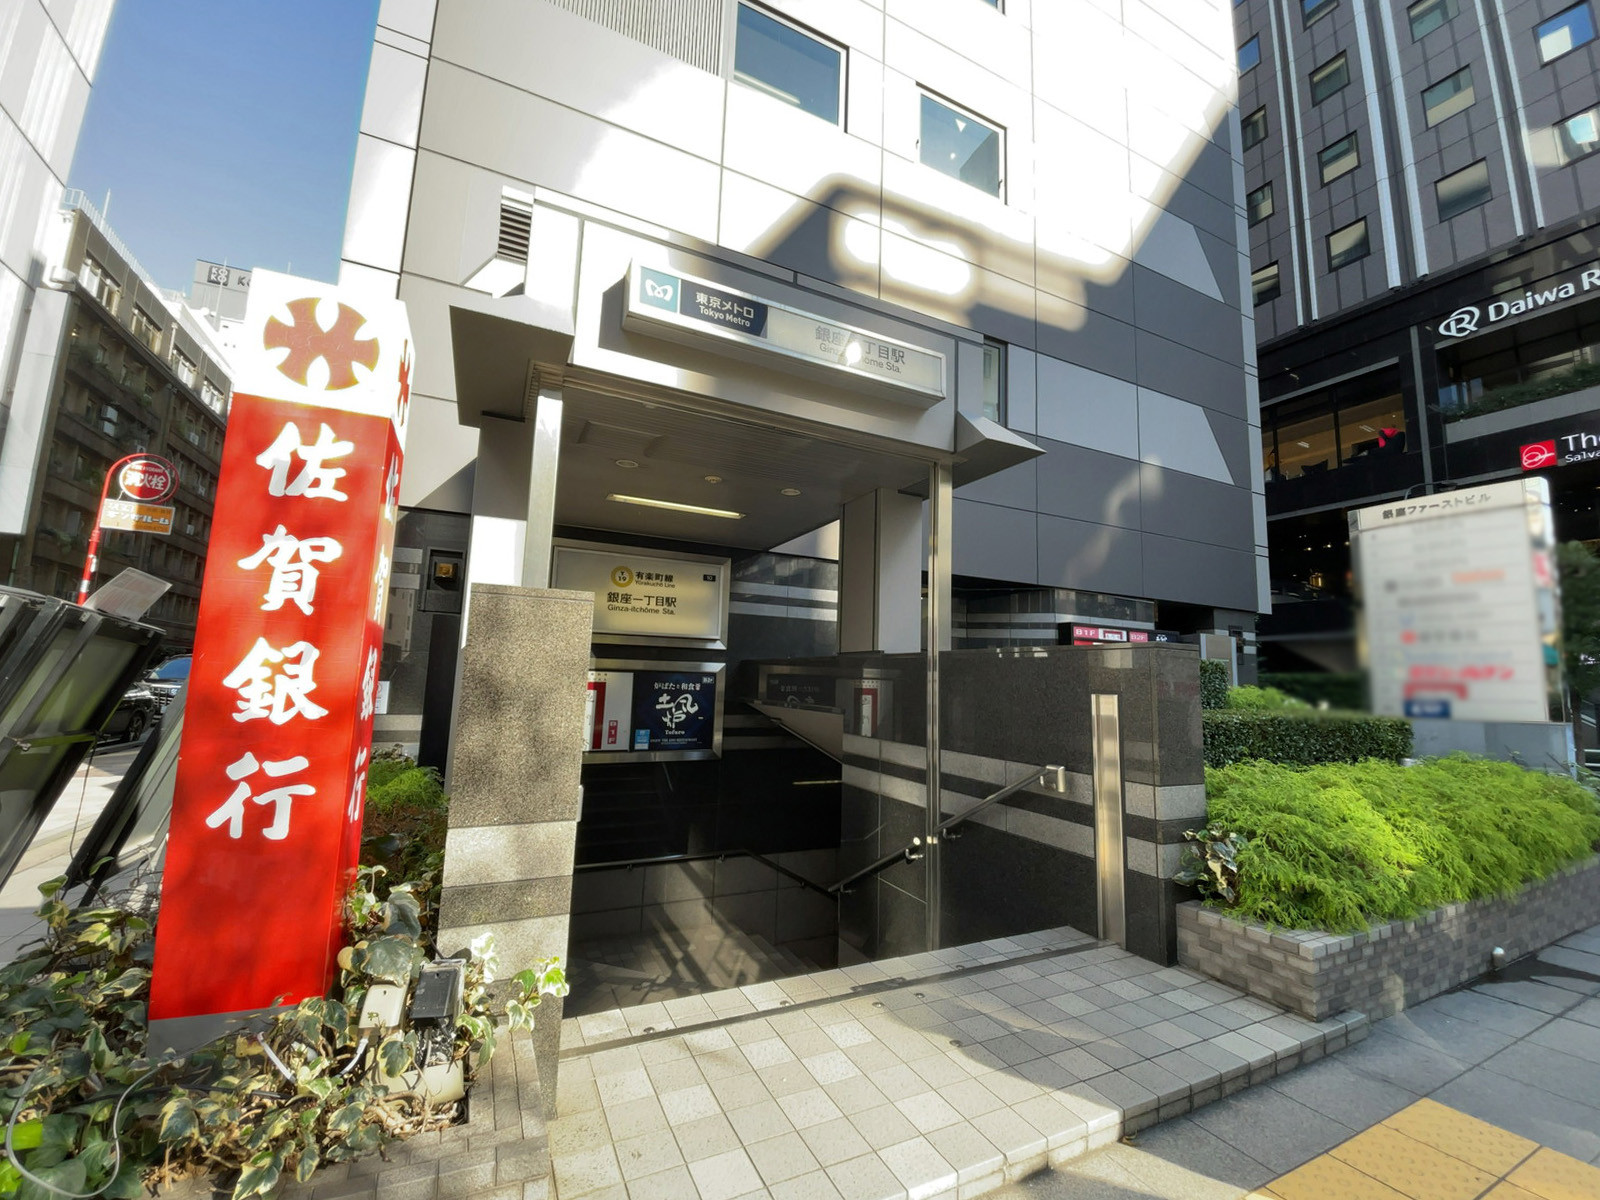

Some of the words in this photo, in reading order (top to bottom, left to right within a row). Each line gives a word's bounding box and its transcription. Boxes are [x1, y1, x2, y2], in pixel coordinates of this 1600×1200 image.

[696, 292, 755, 319] 東京メトロ
[1488, 282, 1576, 322] Daiwa
[699, 305, 725, 320] Tokyo
[725, 313, 751, 327] Metro
[815, 325, 906, 365] 銀座丁目駅
[1561, 432, 1600, 452] Th
[635, 571, 674, 583] 有楽町線
[607, 591, 677, 608] 銀座一丁目駅
[662, 608, 676, 616] Sta.
[206, 421, 355, 842] 佐賀銀行
[1075, 628, 1096, 637] B1F
